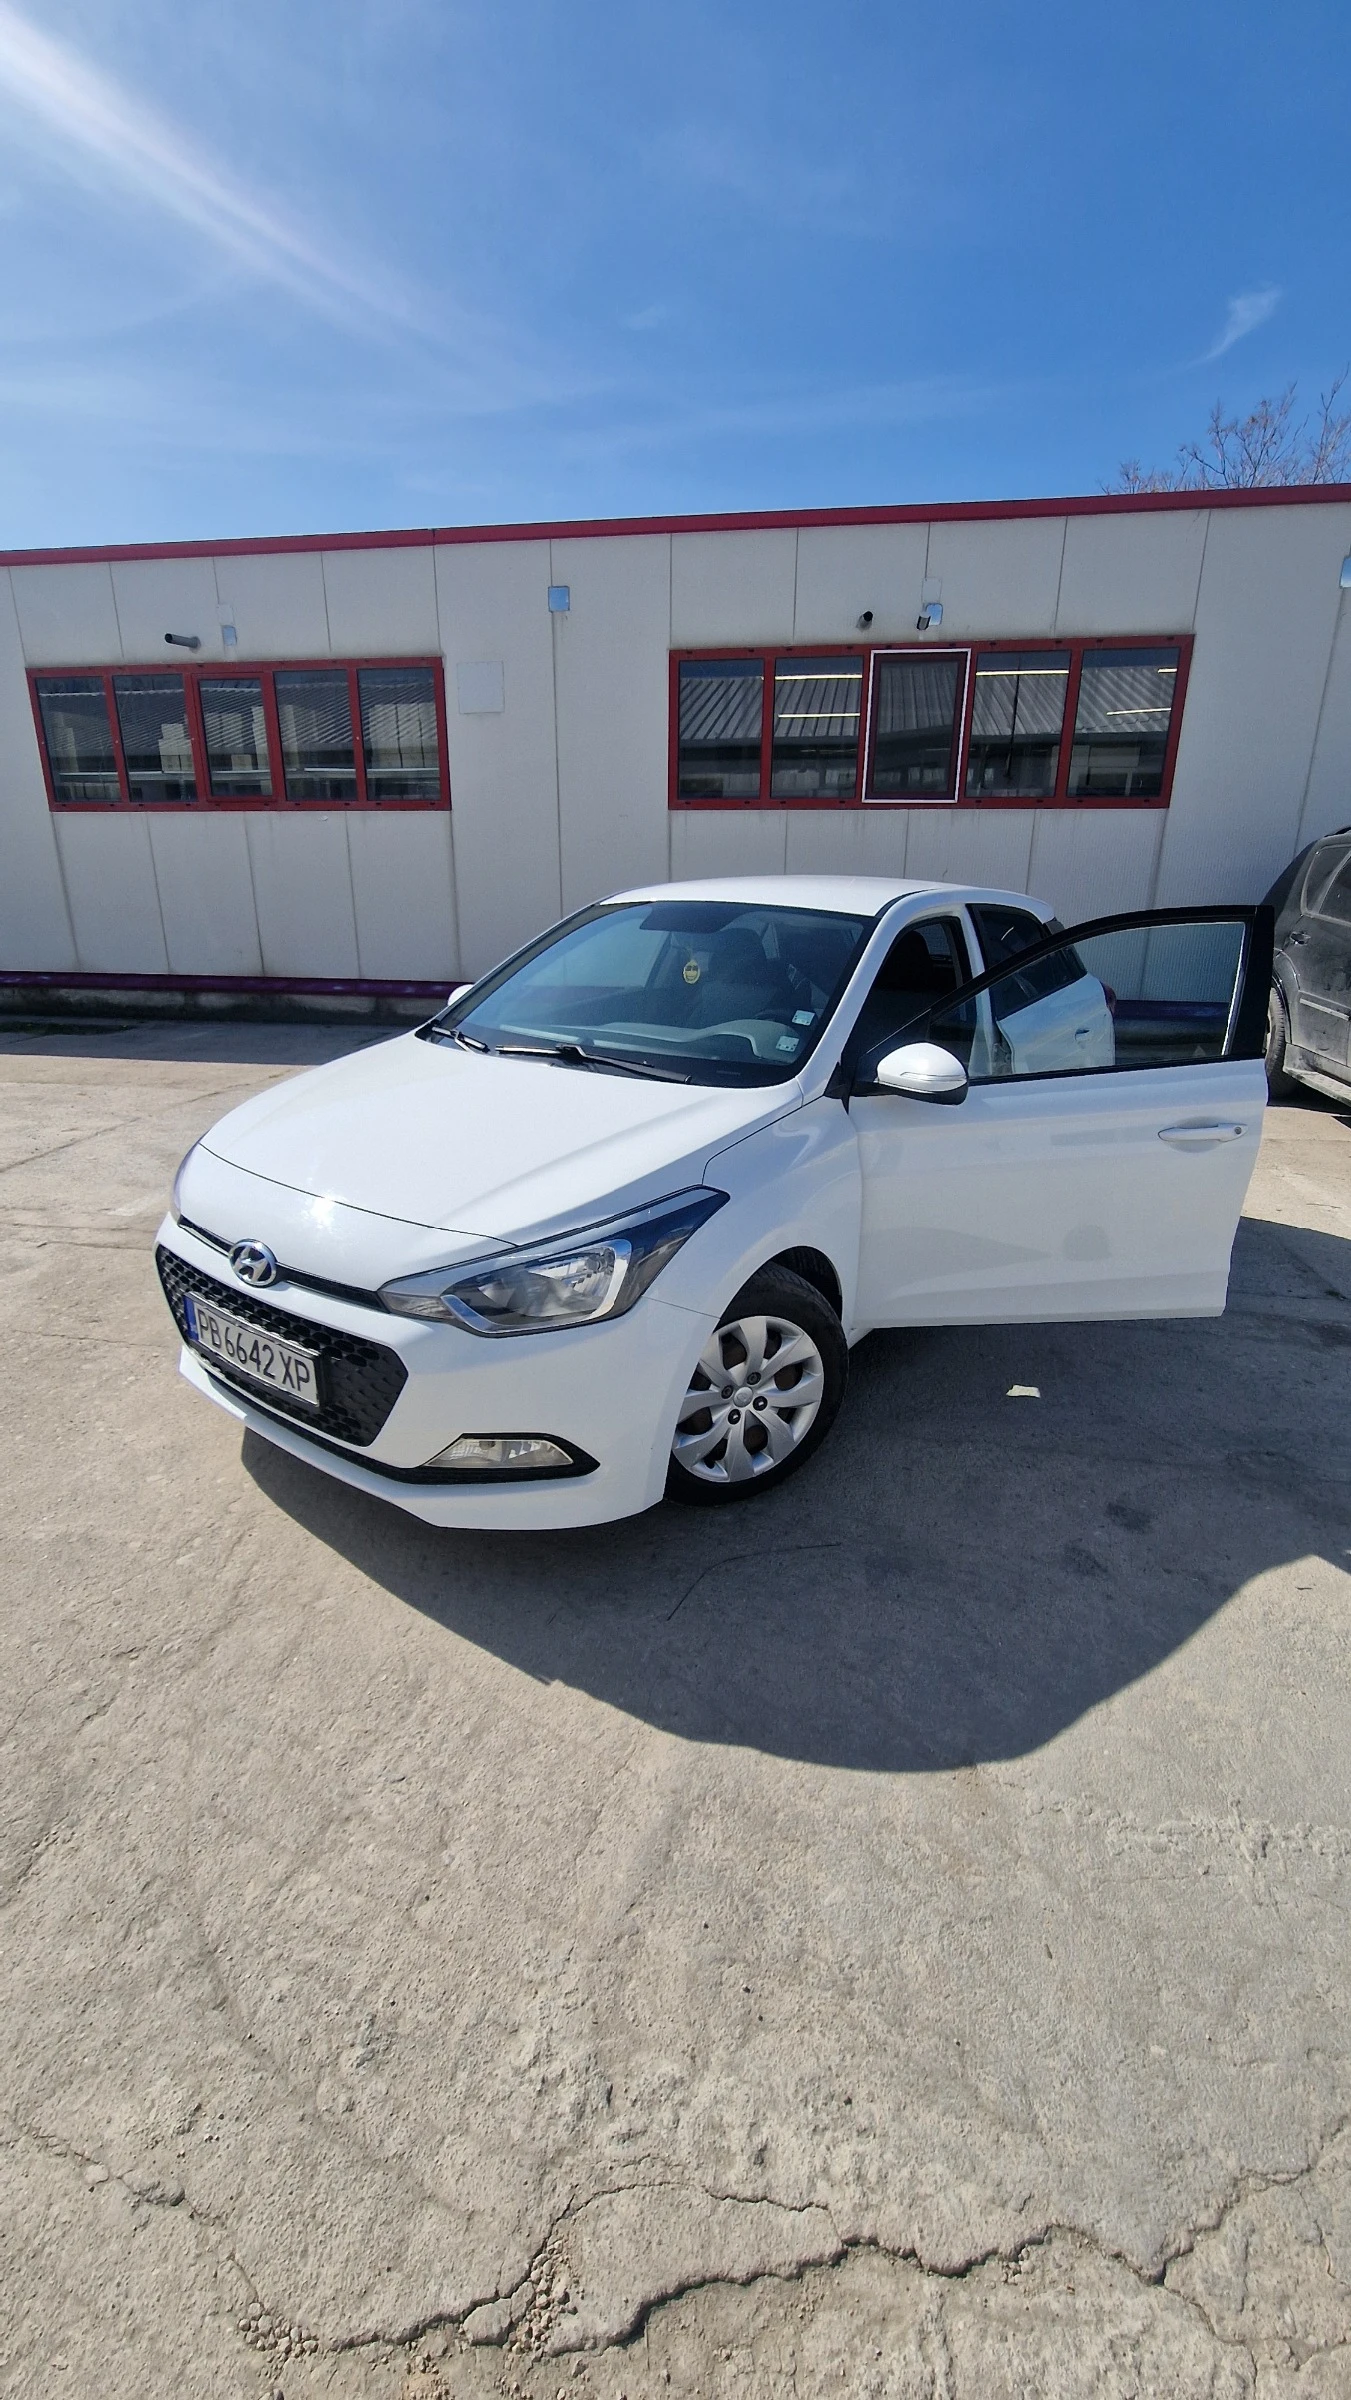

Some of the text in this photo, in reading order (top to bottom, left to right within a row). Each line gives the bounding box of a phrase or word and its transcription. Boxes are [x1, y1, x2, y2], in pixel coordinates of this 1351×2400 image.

[198, 1310, 310, 1391] PB 6642 XP
